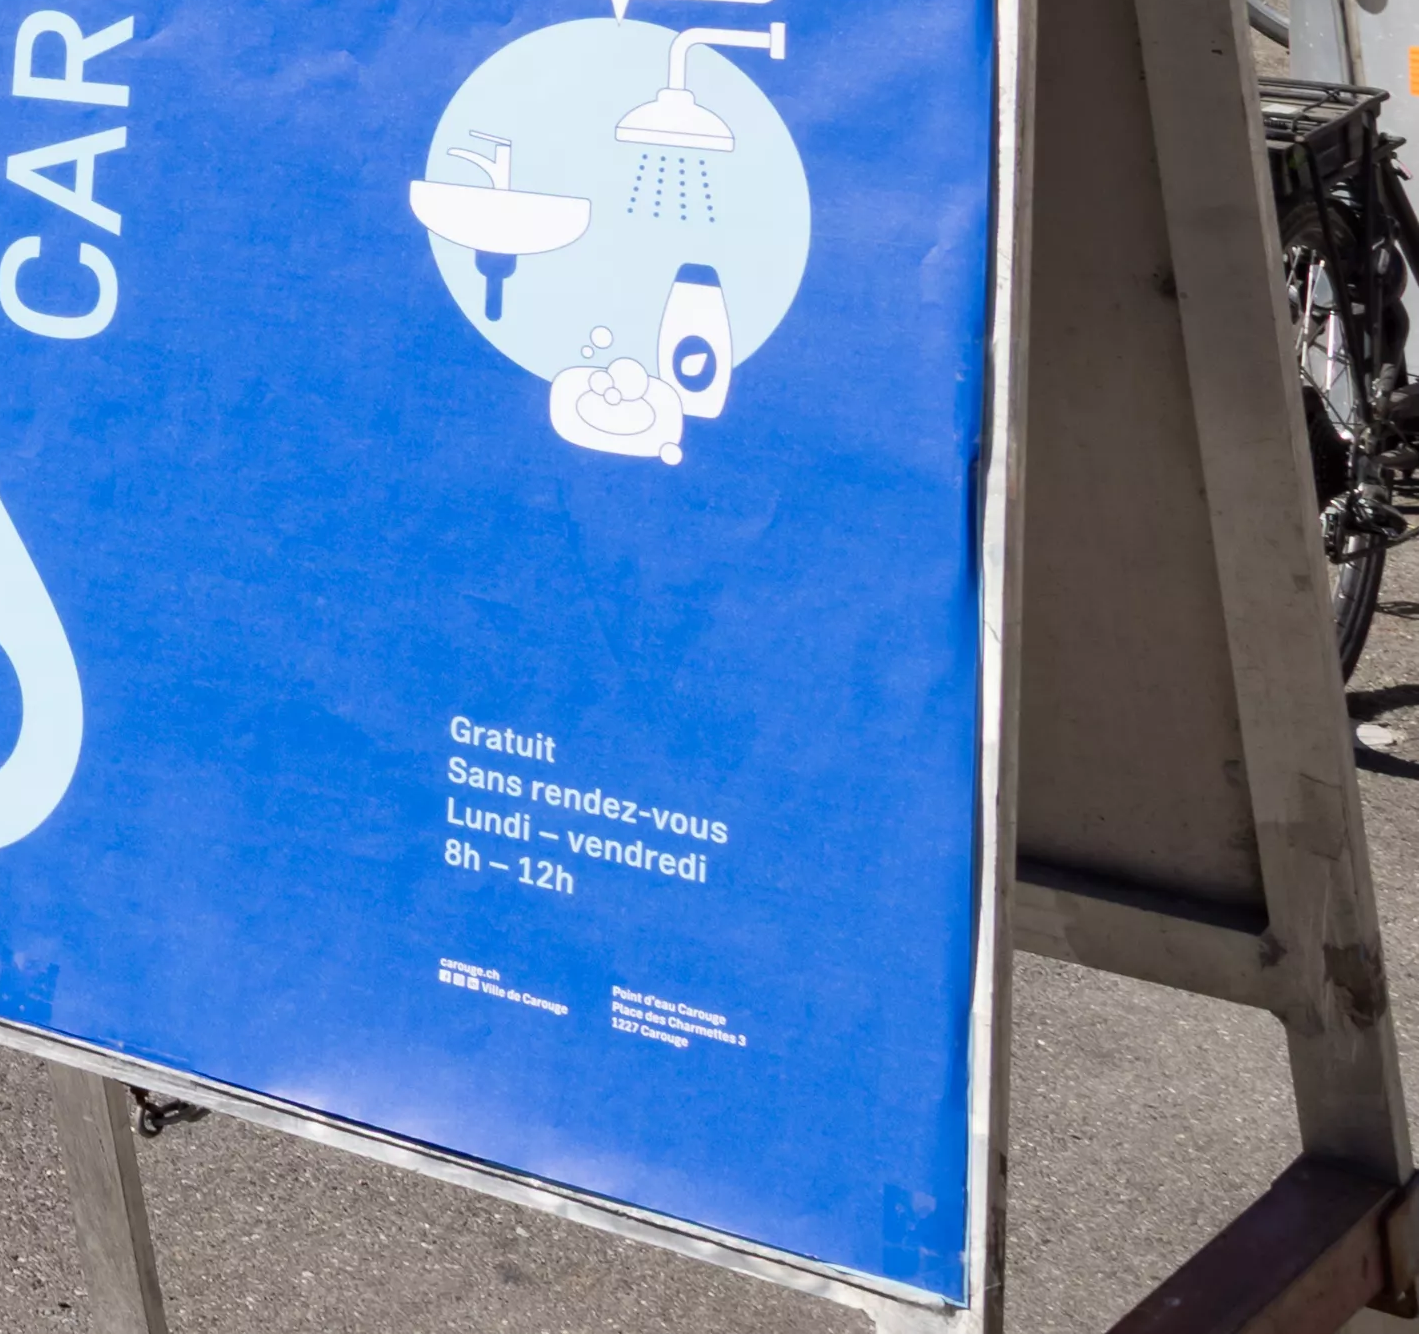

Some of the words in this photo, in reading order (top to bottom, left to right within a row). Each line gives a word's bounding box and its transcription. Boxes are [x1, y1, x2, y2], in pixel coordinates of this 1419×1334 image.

[450, 716, 557, 763] Gratuit
[448, 757, 522, 796] Sans
[531, 780, 729, 844] rendez-vous
[447, 797, 530, 841] Lundi
[568, 830, 707, 883] vendredi
[444, 839, 480, 871] 8h
[518, 857, 574, 894] 12h
[440, 958, 500, 981] carouge.ch
[481, 981, 506, 998] Ville
[507, 989, 521, 1002] de
[522, 993, 569, 1015] Carouge
[612, 985, 642, 1004] Point
[643, 994, 676, 1012] d'eau
[677, 1003, 726, 1026] Carouge
[611, 1016, 639, 1033] 1227
[640, 1024, 689, 1048] Carouge
[612, 1001, 643, 1019] Place
[645, 1010, 666, 1025] des
[668, 1016, 736, 1044] Charmettes
[738, 1034, 746, 1047] 3
